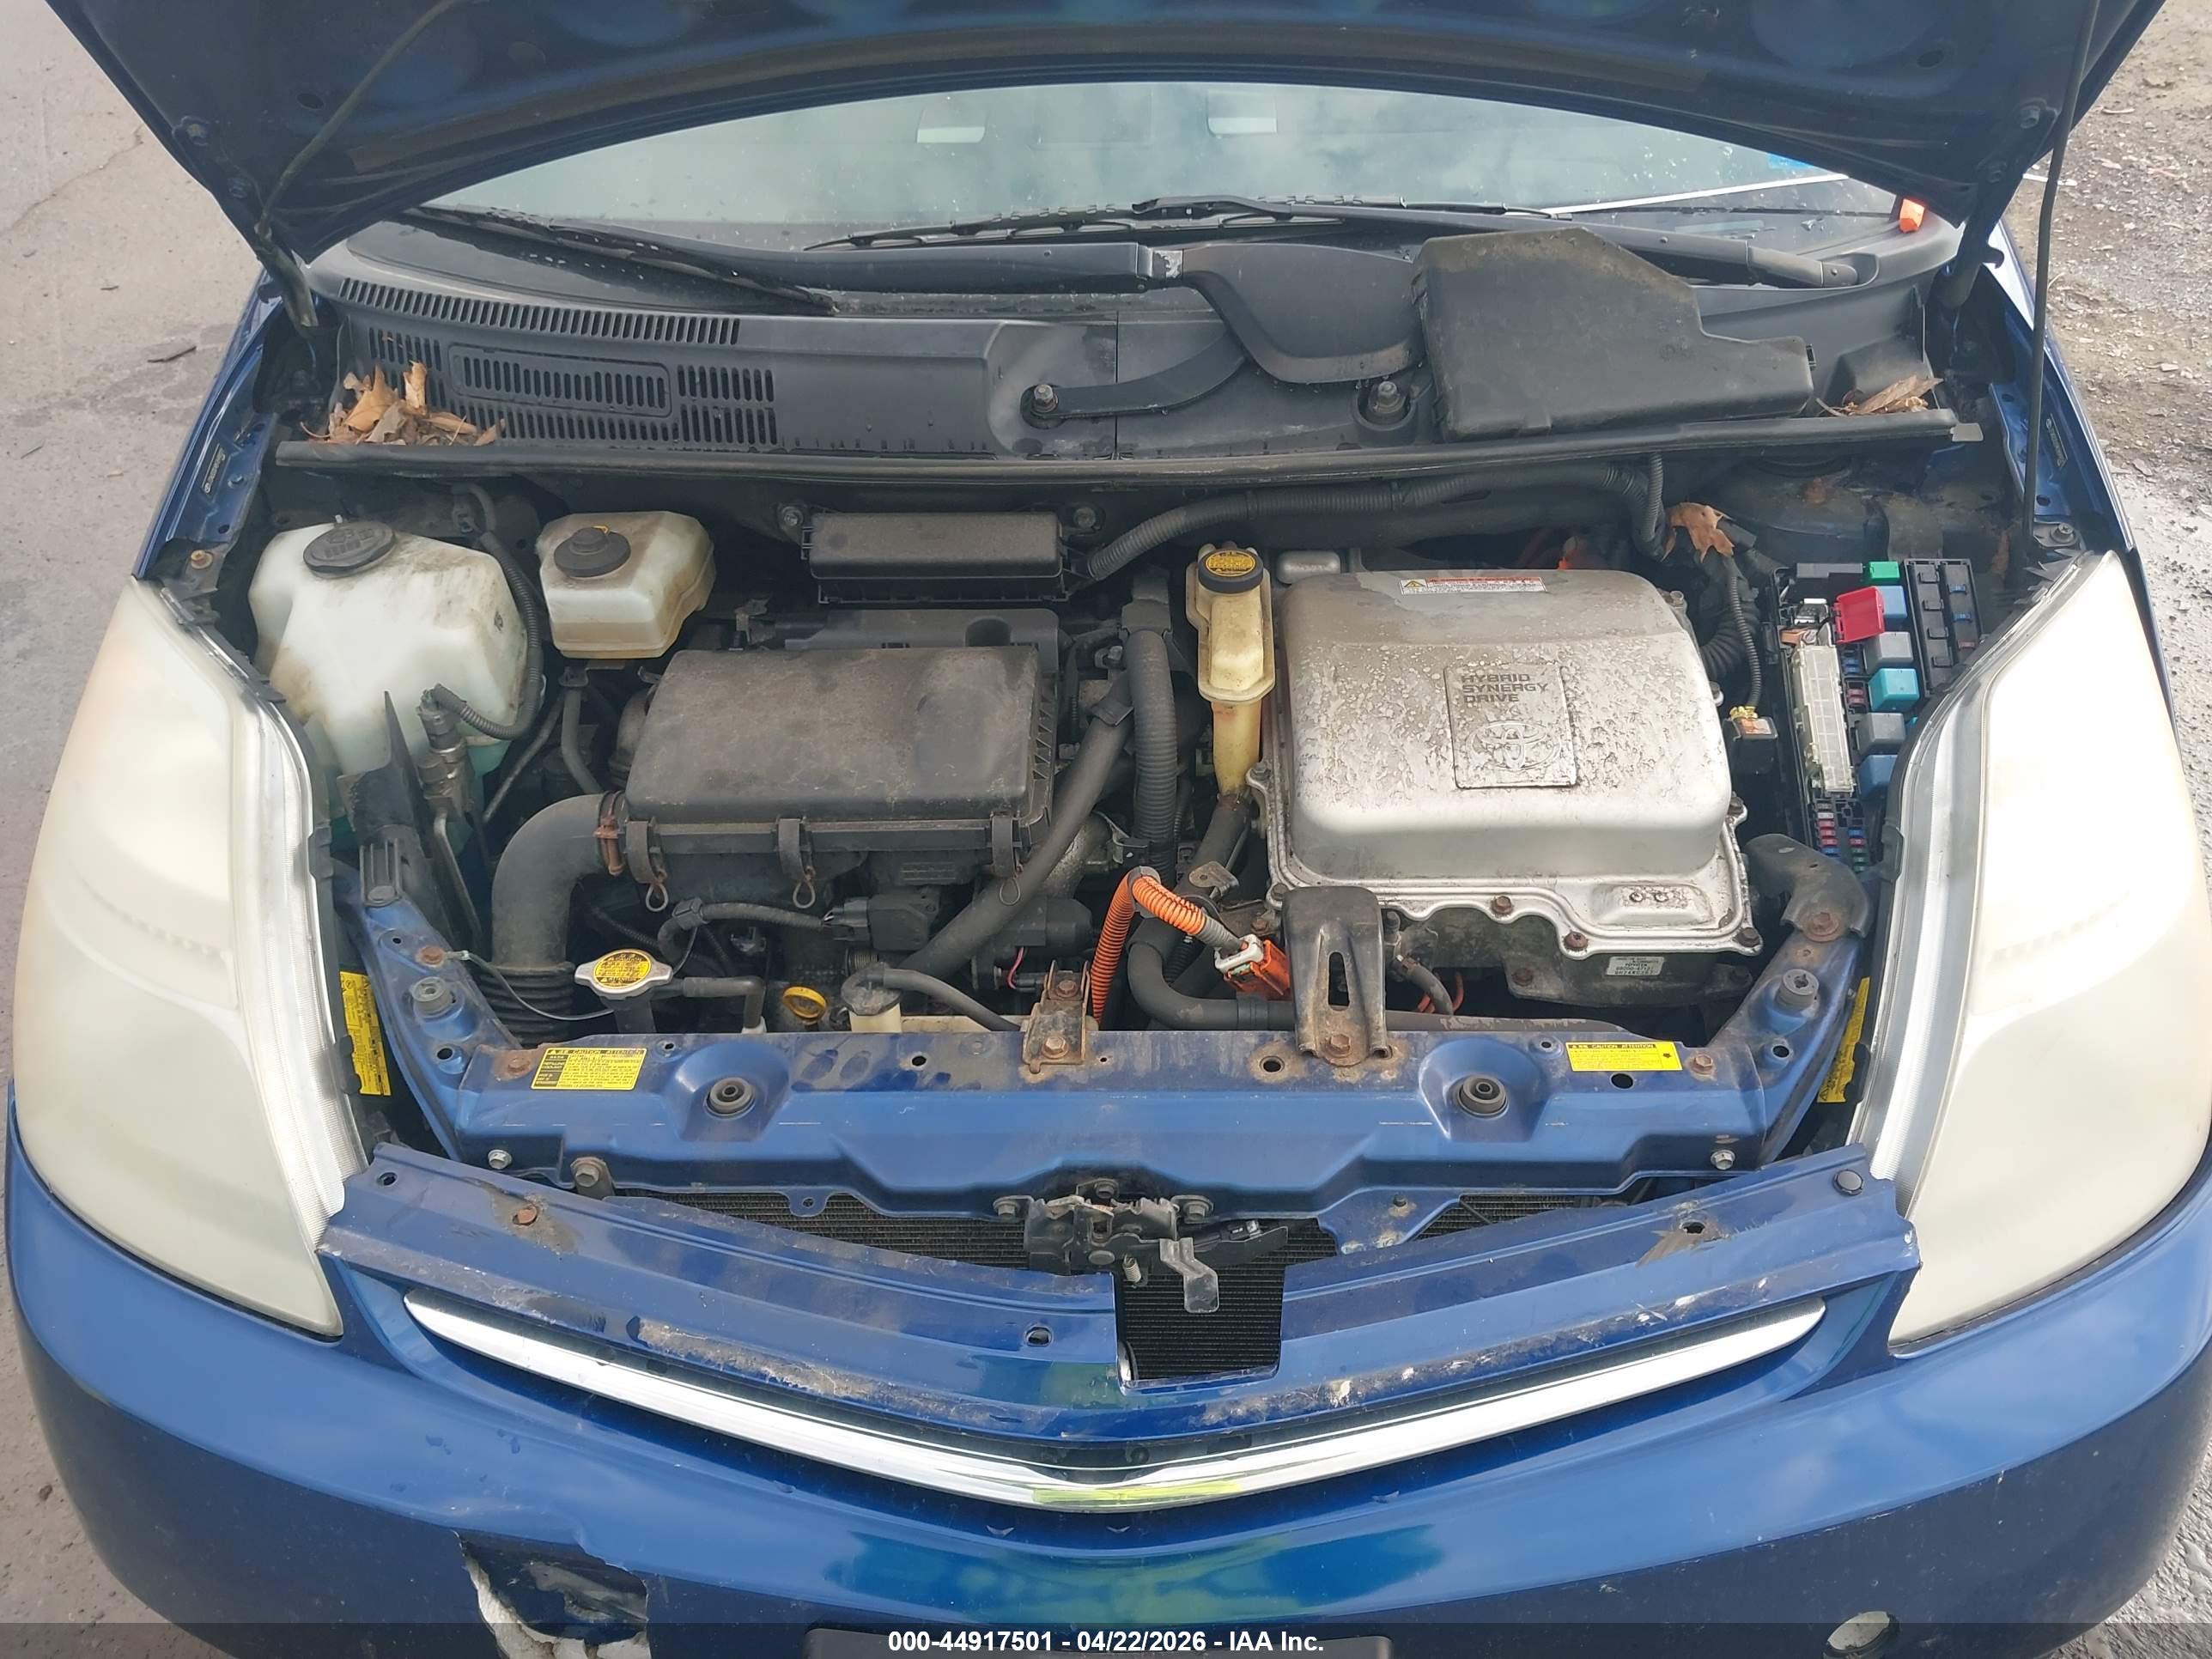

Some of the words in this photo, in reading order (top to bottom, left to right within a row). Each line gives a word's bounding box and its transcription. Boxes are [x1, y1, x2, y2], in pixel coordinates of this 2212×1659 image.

[1462, 673, 1530, 683] HYBRID
[1462, 683, 1548, 693] SYNERGY
[1463, 693, 1519, 702] DRIVE
